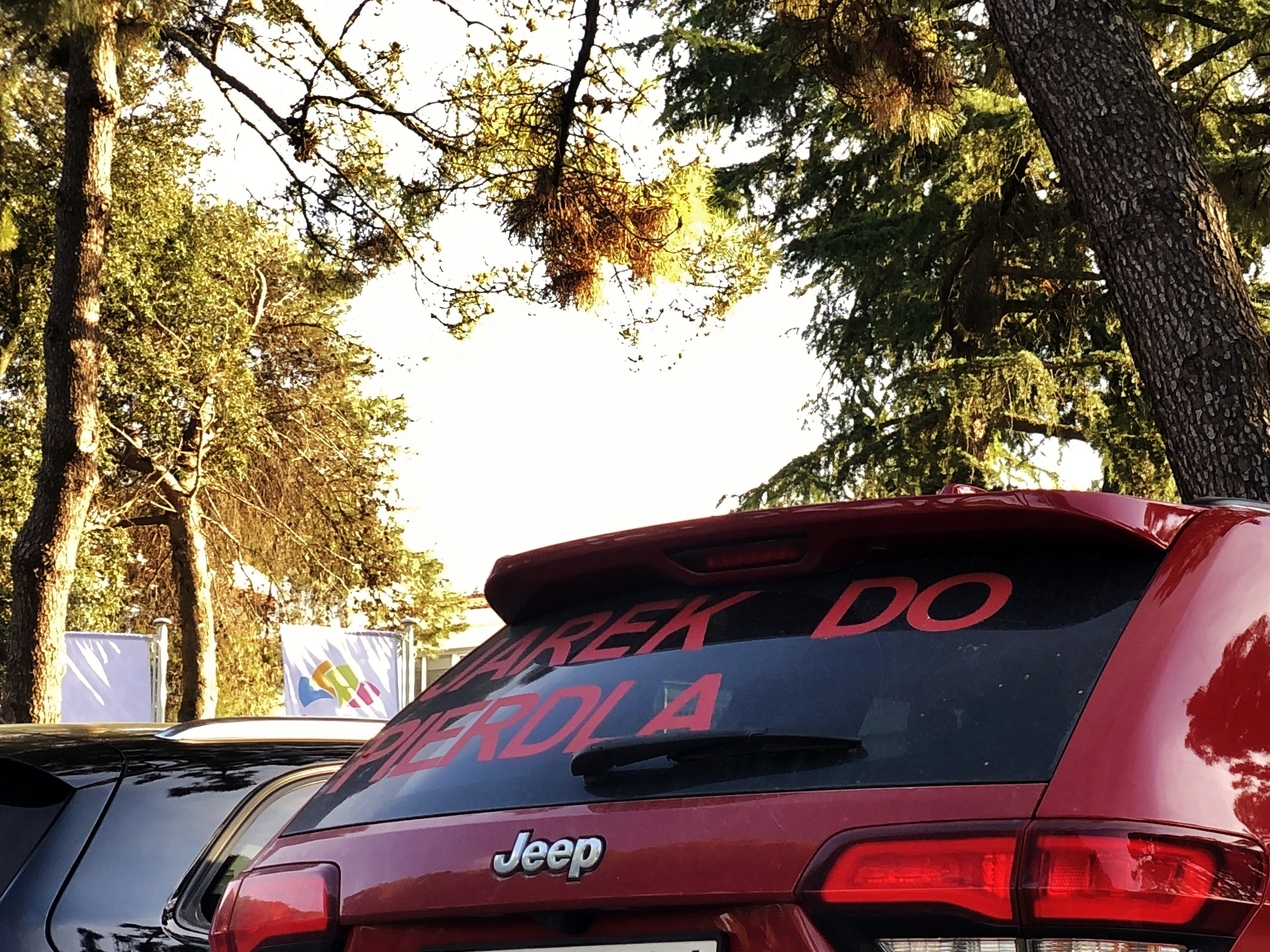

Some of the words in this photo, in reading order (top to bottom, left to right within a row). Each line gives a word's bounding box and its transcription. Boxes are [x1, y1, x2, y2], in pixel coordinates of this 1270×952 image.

[420, 590, 763, 702] JAREK
[810, 571, 1014, 640] DO
[492, 830, 605, 881] Jeep
